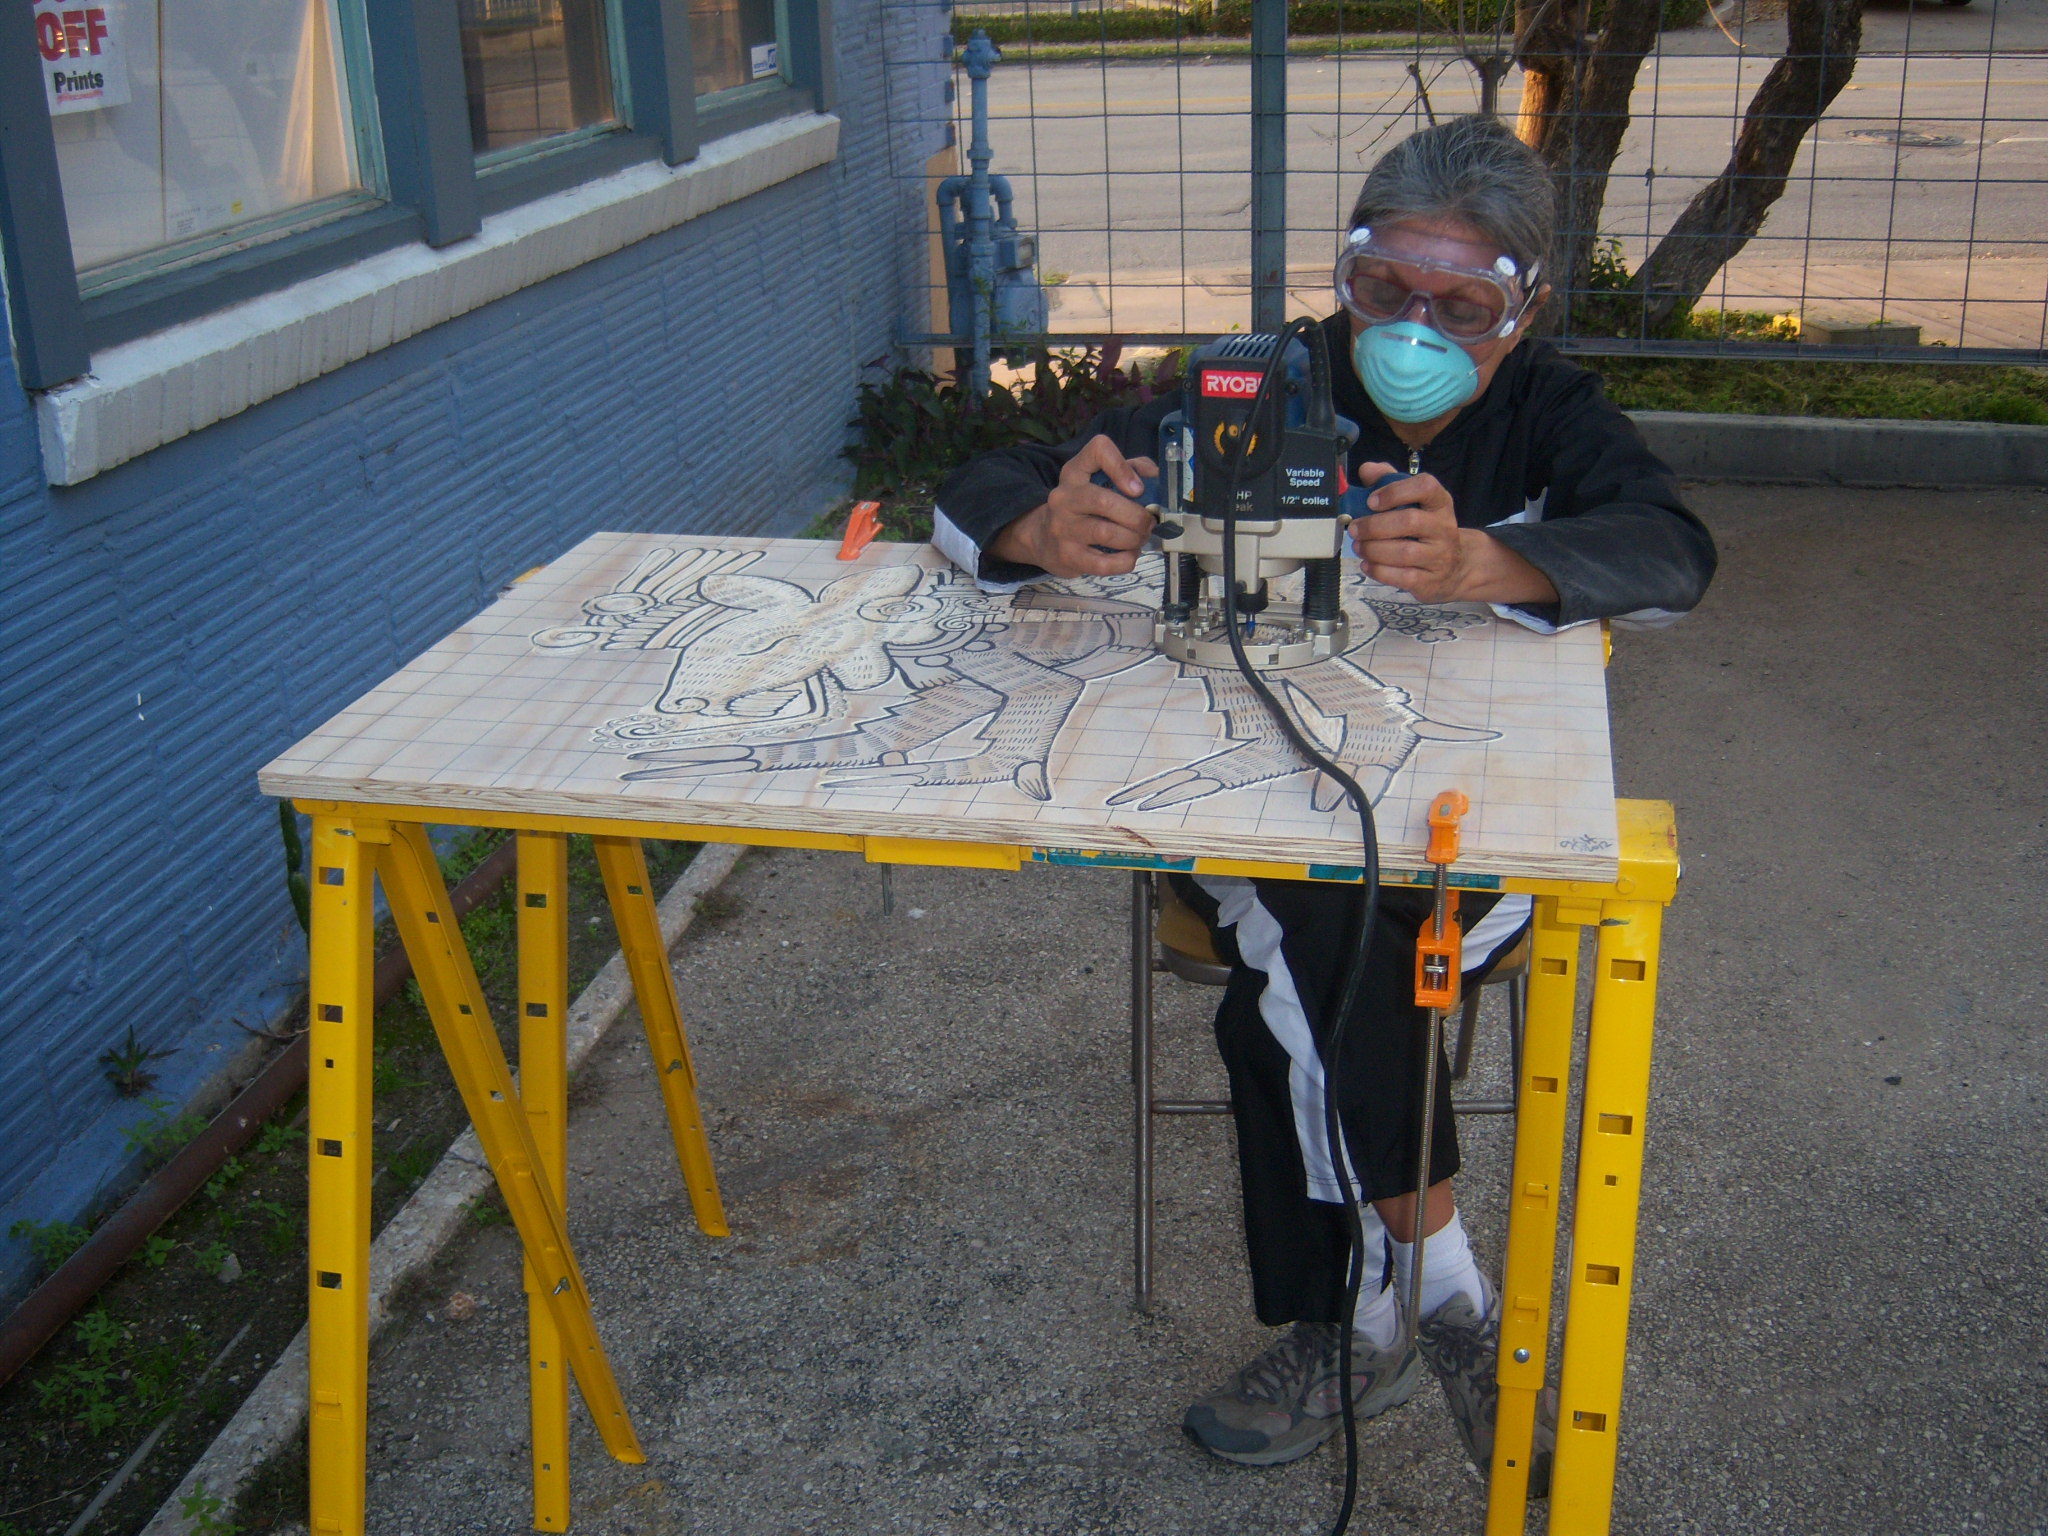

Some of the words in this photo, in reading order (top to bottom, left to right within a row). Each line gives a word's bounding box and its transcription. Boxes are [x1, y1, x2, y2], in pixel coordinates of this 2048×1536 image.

[35, 8, 108, 62] OFF
[53, 71, 104, 93] Prints
[1285, 468, 1325, 478] Variable
[1289, 477, 1321, 488] Speed
[1301, 496, 1329, 506] collet
